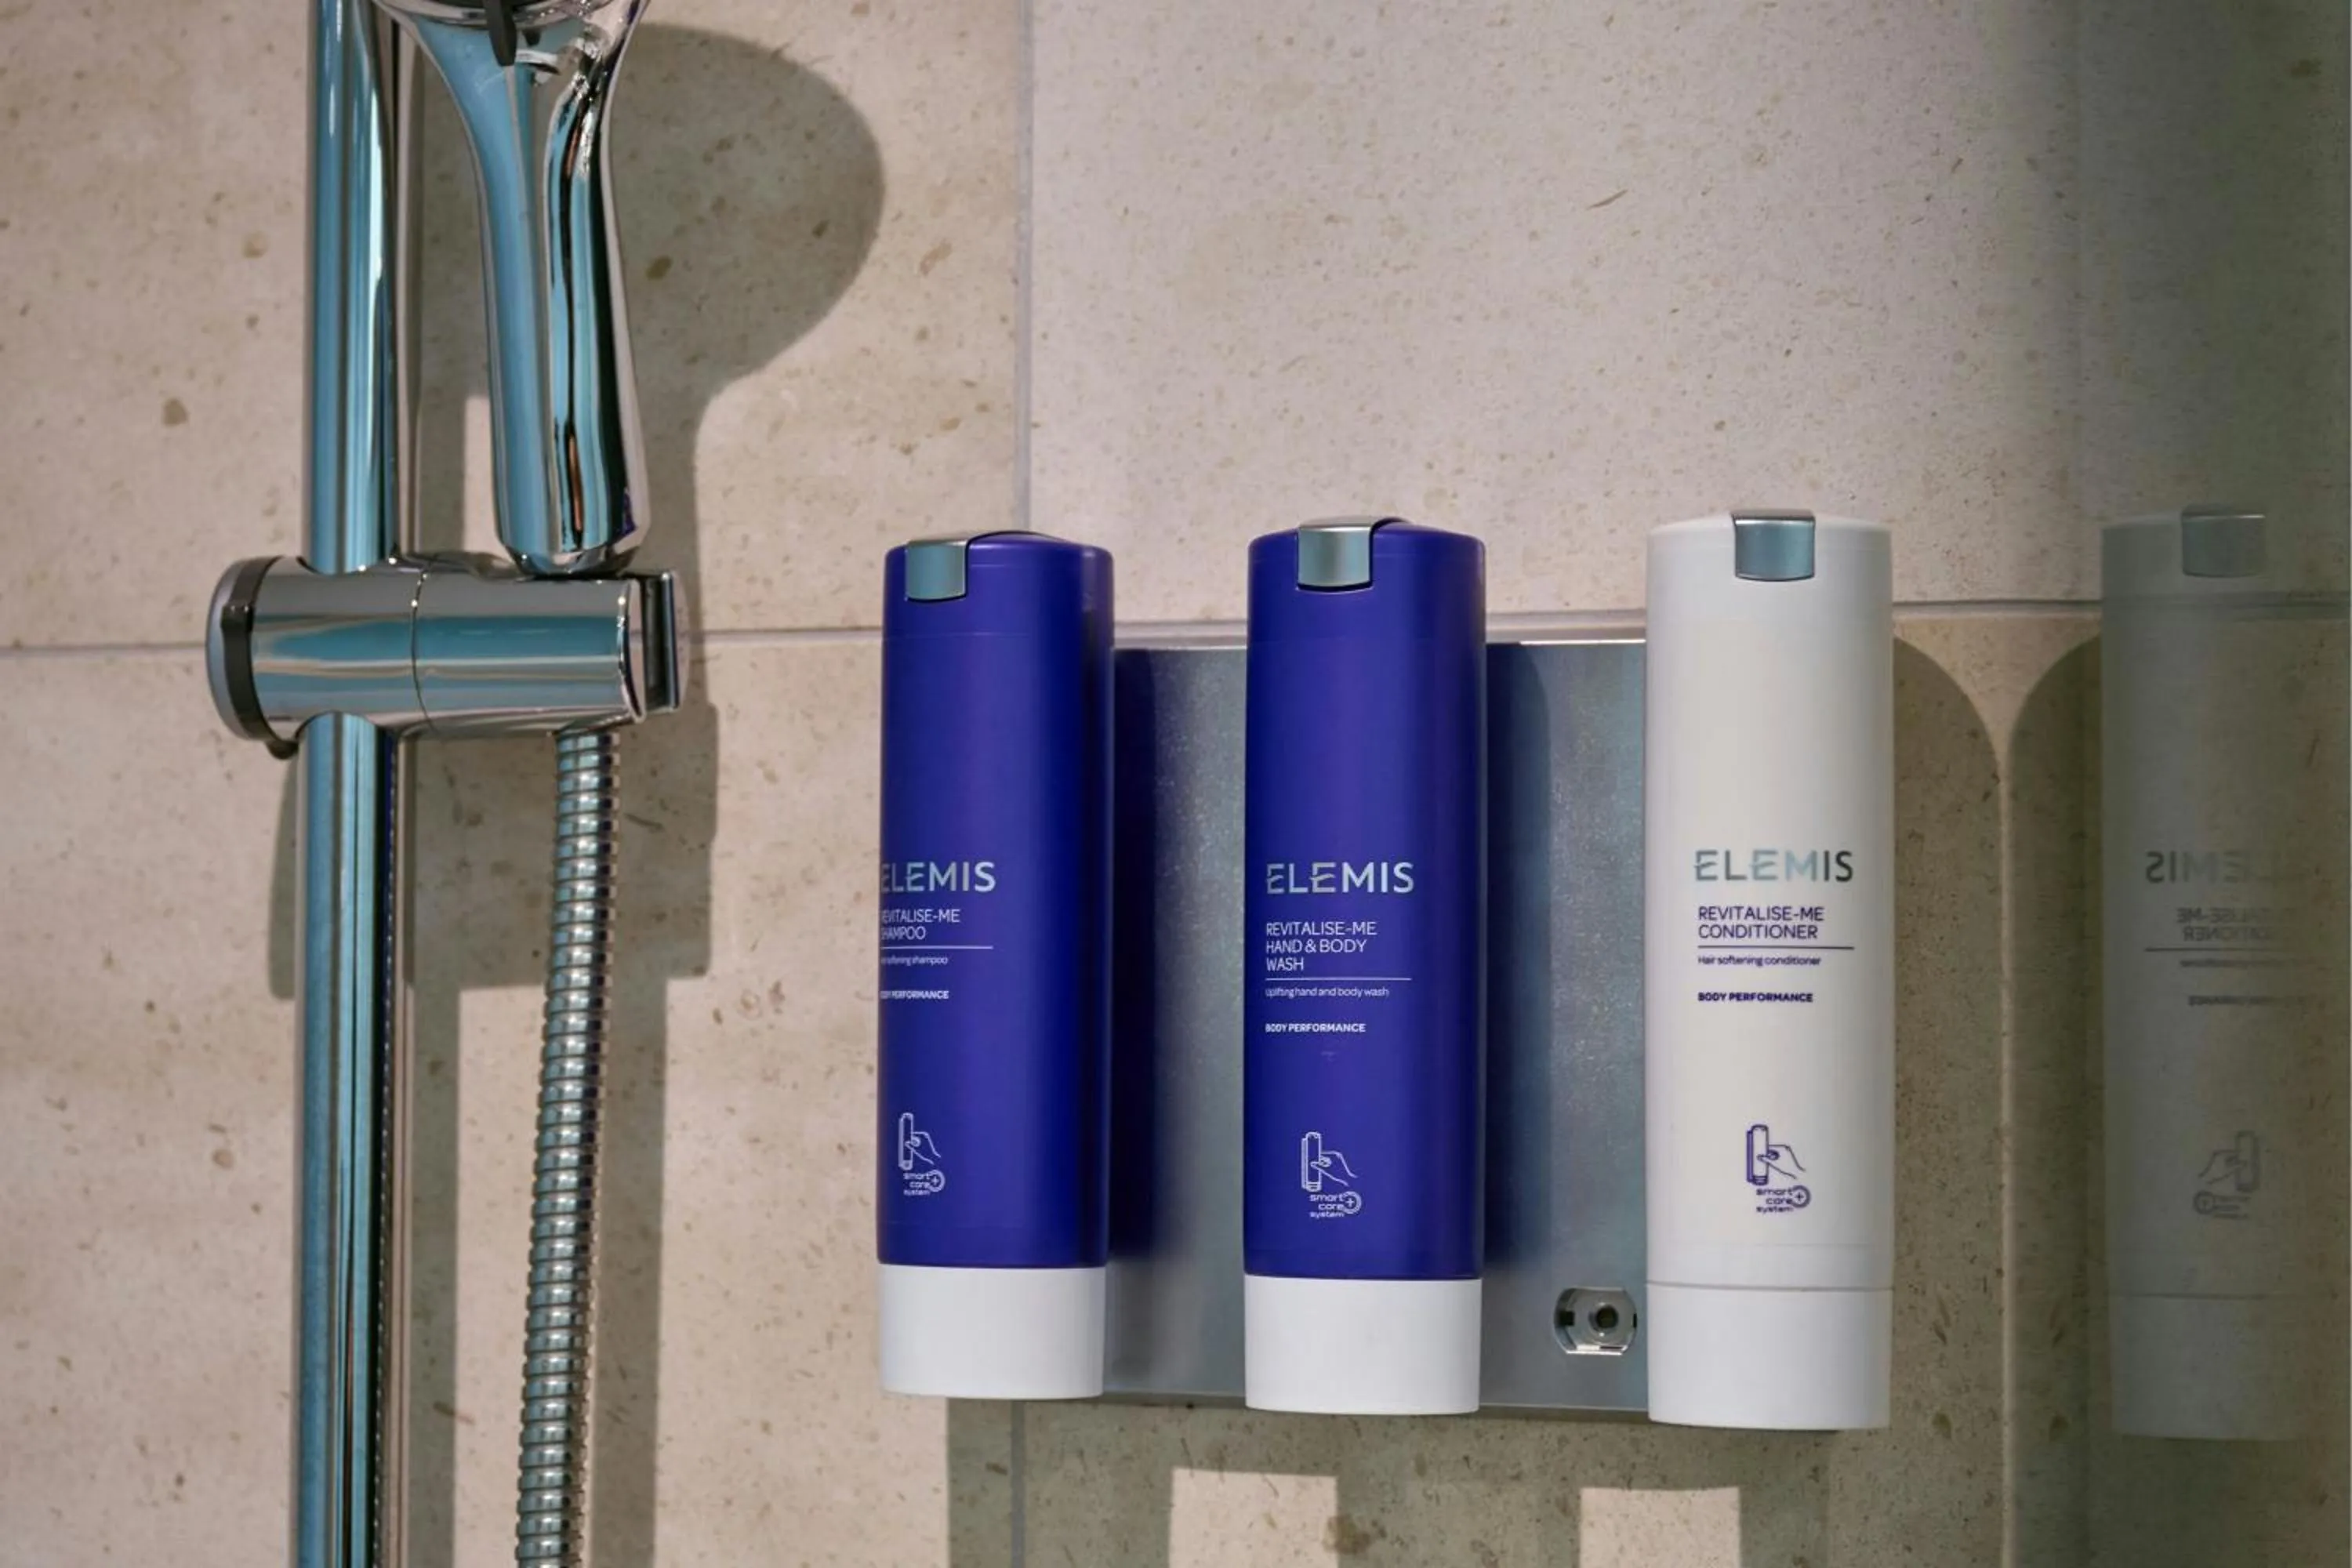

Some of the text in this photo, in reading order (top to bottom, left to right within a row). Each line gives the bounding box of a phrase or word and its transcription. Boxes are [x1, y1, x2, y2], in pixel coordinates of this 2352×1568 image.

[1694, 849, 1853, 882] ELEMIS
[1266, 862, 1414, 894] ELEMIS
[881, 908, 961, 924] EVITALISE-ME
[1697, 906, 1825, 921] REVITALISE-ME
[1265, 921, 1377, 936] REVITALISE-ME
[1697, 924, 1819, 939] CONDITIONER
[1265, 939, 1367, 953] HAND & BODY
[1266, 956, 1305, 971] WASH
[1717, 954, 1763, 967] softening
[1764, 956, 1821, 966] conditioner
[1294, 986, 1317, 997] hand
[1319, 987, 1337, 996] and
[1338, 986, 1363, 999] body
[1363, 986, 1389, 997] wash
[1697, 992, 1813, 1003] BODY PERFORMANCE
[1265, 1023, 1367, 1033] BODY PERFORMANCE
